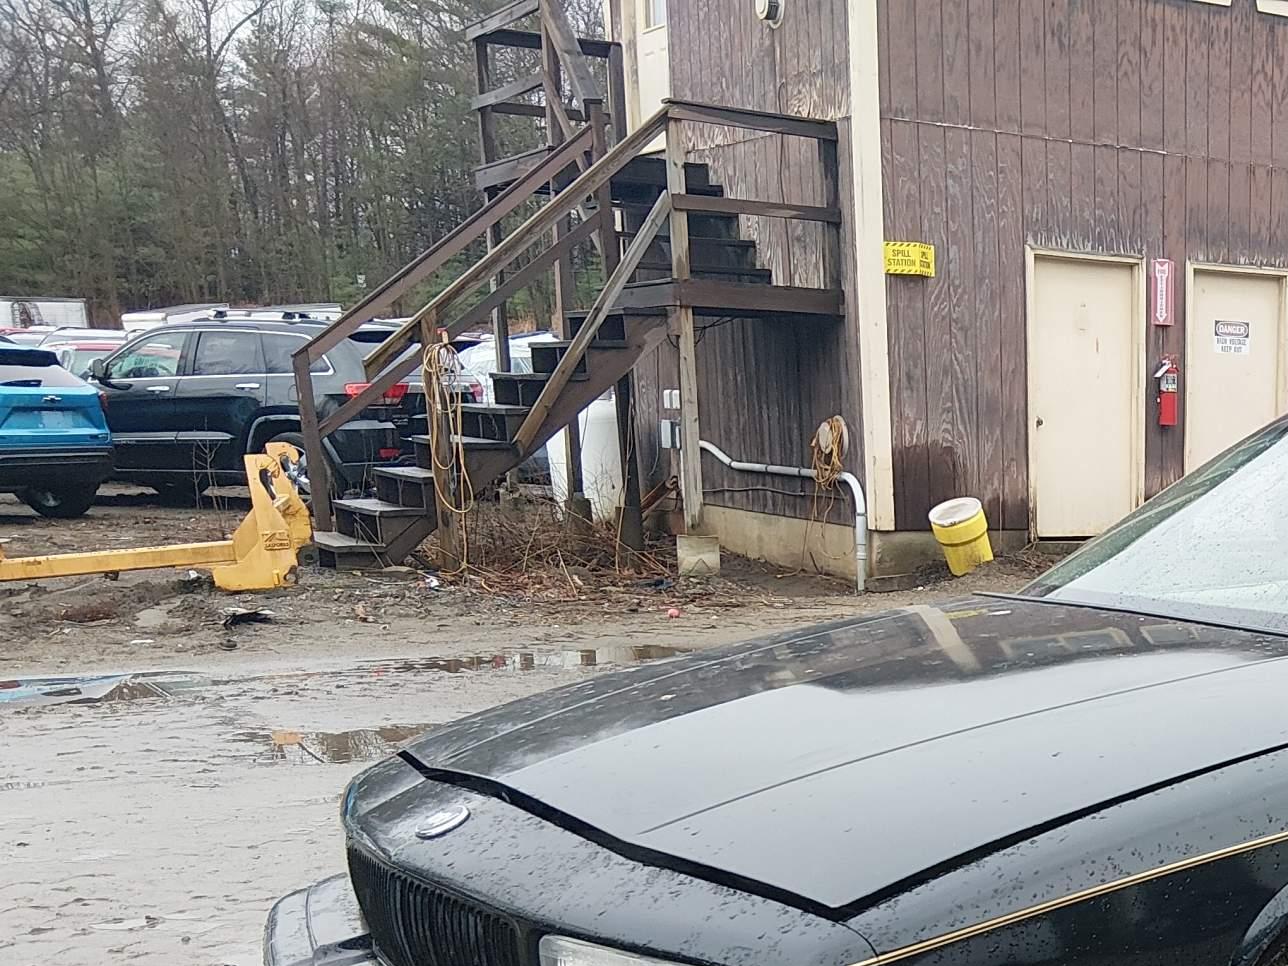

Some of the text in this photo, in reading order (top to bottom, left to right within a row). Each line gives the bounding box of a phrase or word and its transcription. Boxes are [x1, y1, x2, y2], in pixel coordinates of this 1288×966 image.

[891, 248, 911, 258] SPILL
[887, 258, 916, 267] STATION
[1219, 324, 1245, 334] DANGER
